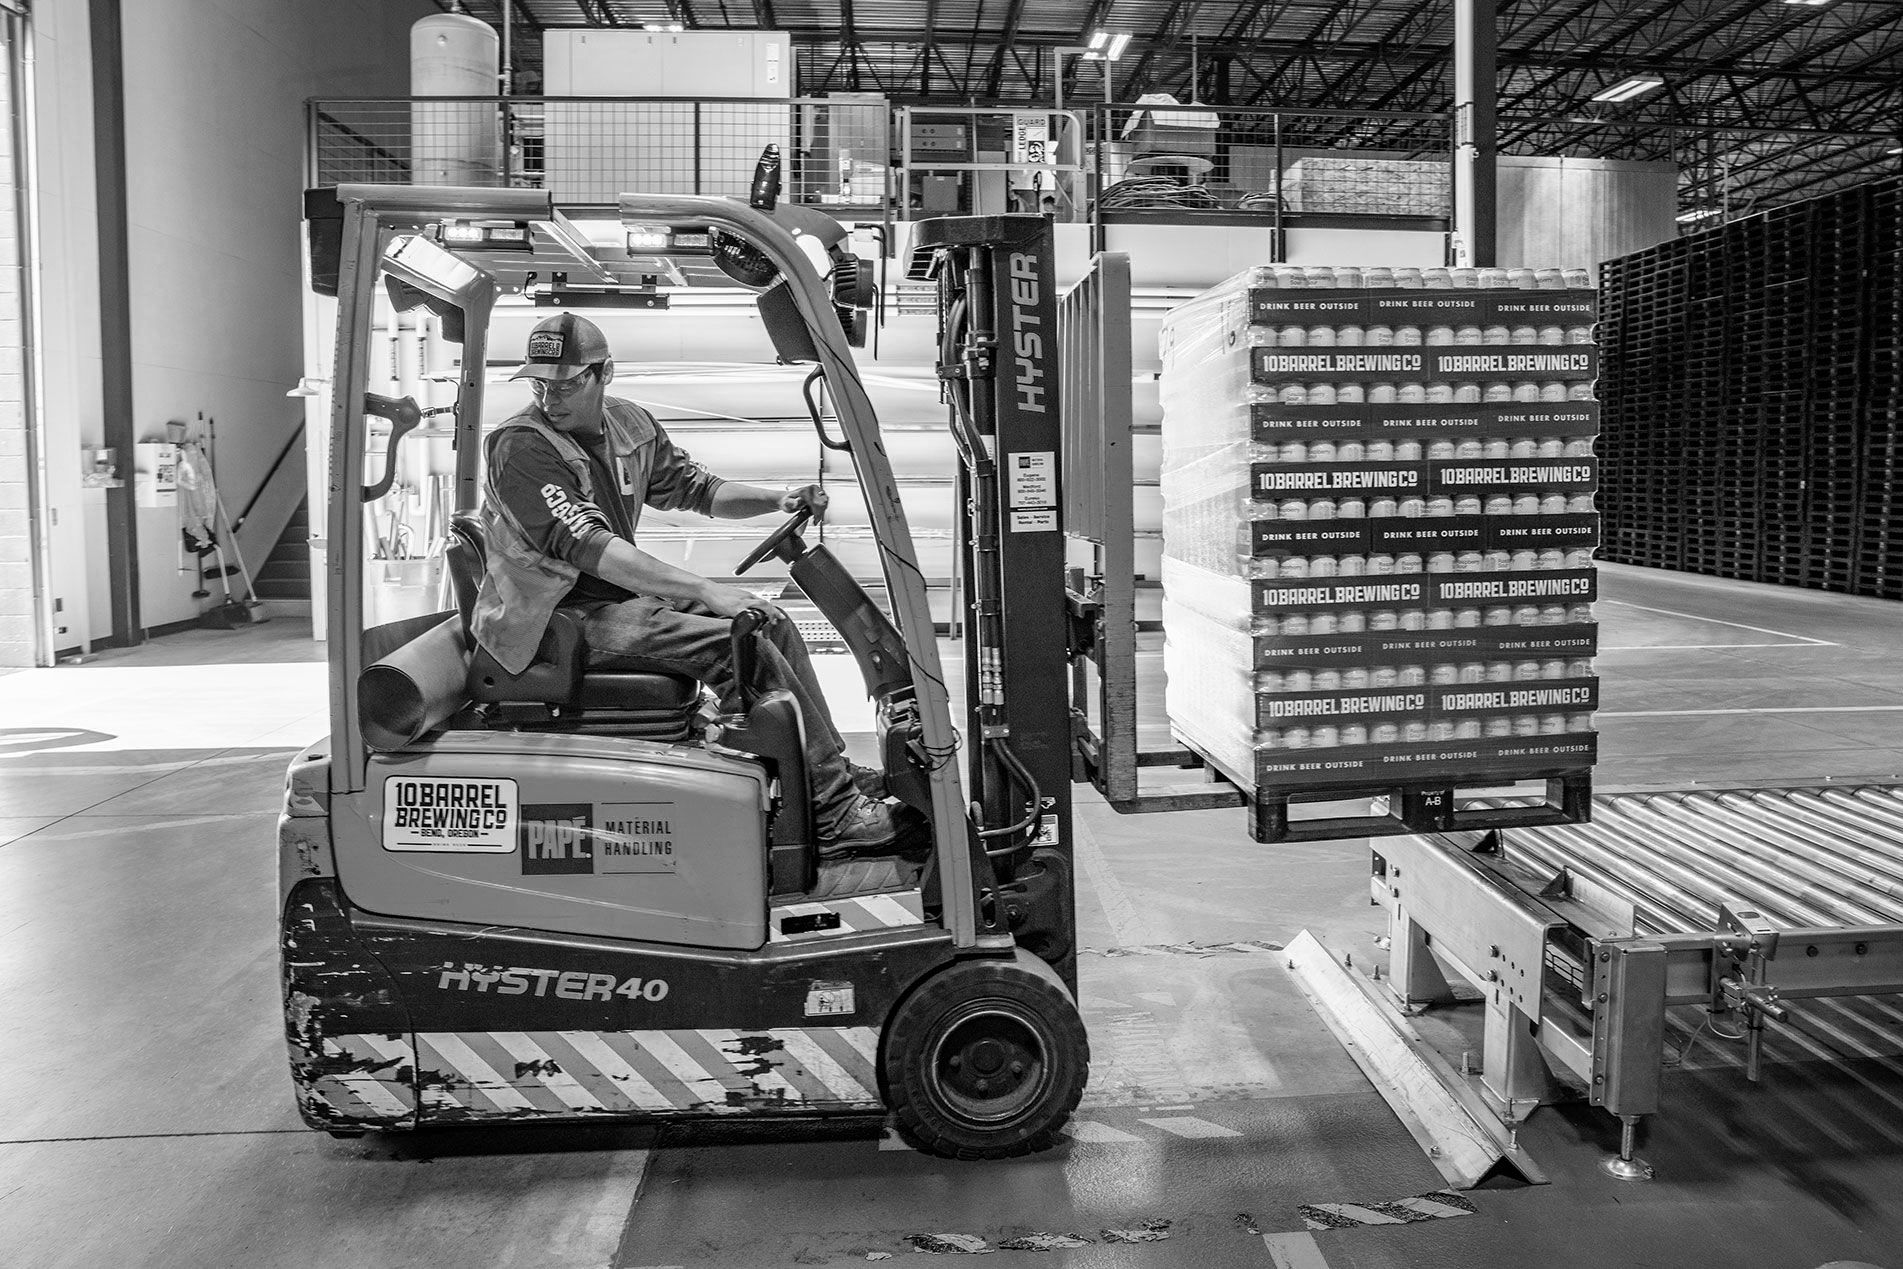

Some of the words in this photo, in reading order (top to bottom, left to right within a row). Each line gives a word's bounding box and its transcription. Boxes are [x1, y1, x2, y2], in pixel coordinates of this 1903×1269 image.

[1259, 302, 1290, 310] DRINK
[1293, 302, 1316, 310] BEER
[1319, 302, 1359, 310] OUTSIDE
[1379, 300, 1409, 308] DRINK
[1412, 300, 1434, 308] BEER
[1436, 300, 1475, 308] OUTSIDE
[1497, 304, 1526, 312] DRINK
[1529, 304, 1550, 312] BEER
[1553, 304, 1591, 312] OUTSIDE
[1010, 252, 1046, 414] HYSTER
[1383, 419, 1412, 427] DRINK
[1415, 419, 1437, 427] BEER
[1440, 418, 1478, 426] OUTSIDE
[1529, 414, 1550, 422] BEER
[1553, 414, 1590, 422] OUTSIDE
[1262, 420, 1293, 428] DRINK
[1296, 420, 1319, 428] BEER
[1321, 419, 1361, 428] OUTSIDE
[1262, 533, 1292, 541] DRINK
[1295, 532, 1318, 540] BEER
[1321, 531, 1361, 540] OUTSIDE
[1383, 531, 1413, 539] DRINK
[1416, 530, 1438, 538] BEER
[1440, 529, 1479, 538] OUTSIDE
[1500, 528, 1528, 536] DRINK
[1531, 528, 1552, 536] BEER
[1555, 526, 1592, 535] OUTSIDE
[1382, 642, 1411, 650] DRINK
[1414, 641, 1436, 649] BEER
[1438, 639, 1477, 648] OUTSIDE
[1498, 641, 1527, 649] DRINK
[1530, 640, 1551, 648] BEER
[1553, 638, 1590, 647] OUTSIDE
[1264, 648, 1295, 657] DRINK
[1298, 647, 1320, 655] BEER
[1323, 645, 1362, 654] OUTSIDE
[1498, 748, 1526, 757] DRINK
[1528, 746, 1550, 755] BEER
[1552, 744, 1589, 754] OUTSIDE
[1383, 754, 1412, 763] DRINK
[1415, 753, 1437, 761] BEER
[1439, 751, 1477, 760] OUTSIDE
[1266, 763, 1296, 772] DRINK
[1299, 762, 1322, 770] BEER
[1324, 760, 1364, 769] OUTSIDE
[1425, 796, 1442, 806] A-B
[395, 808, 480, 828] BREWING
[605, 820, 672, 836] MATERIAL
[447, 830, 480, 838] OREGON
[604, 840, 672, 856] HANDLING
